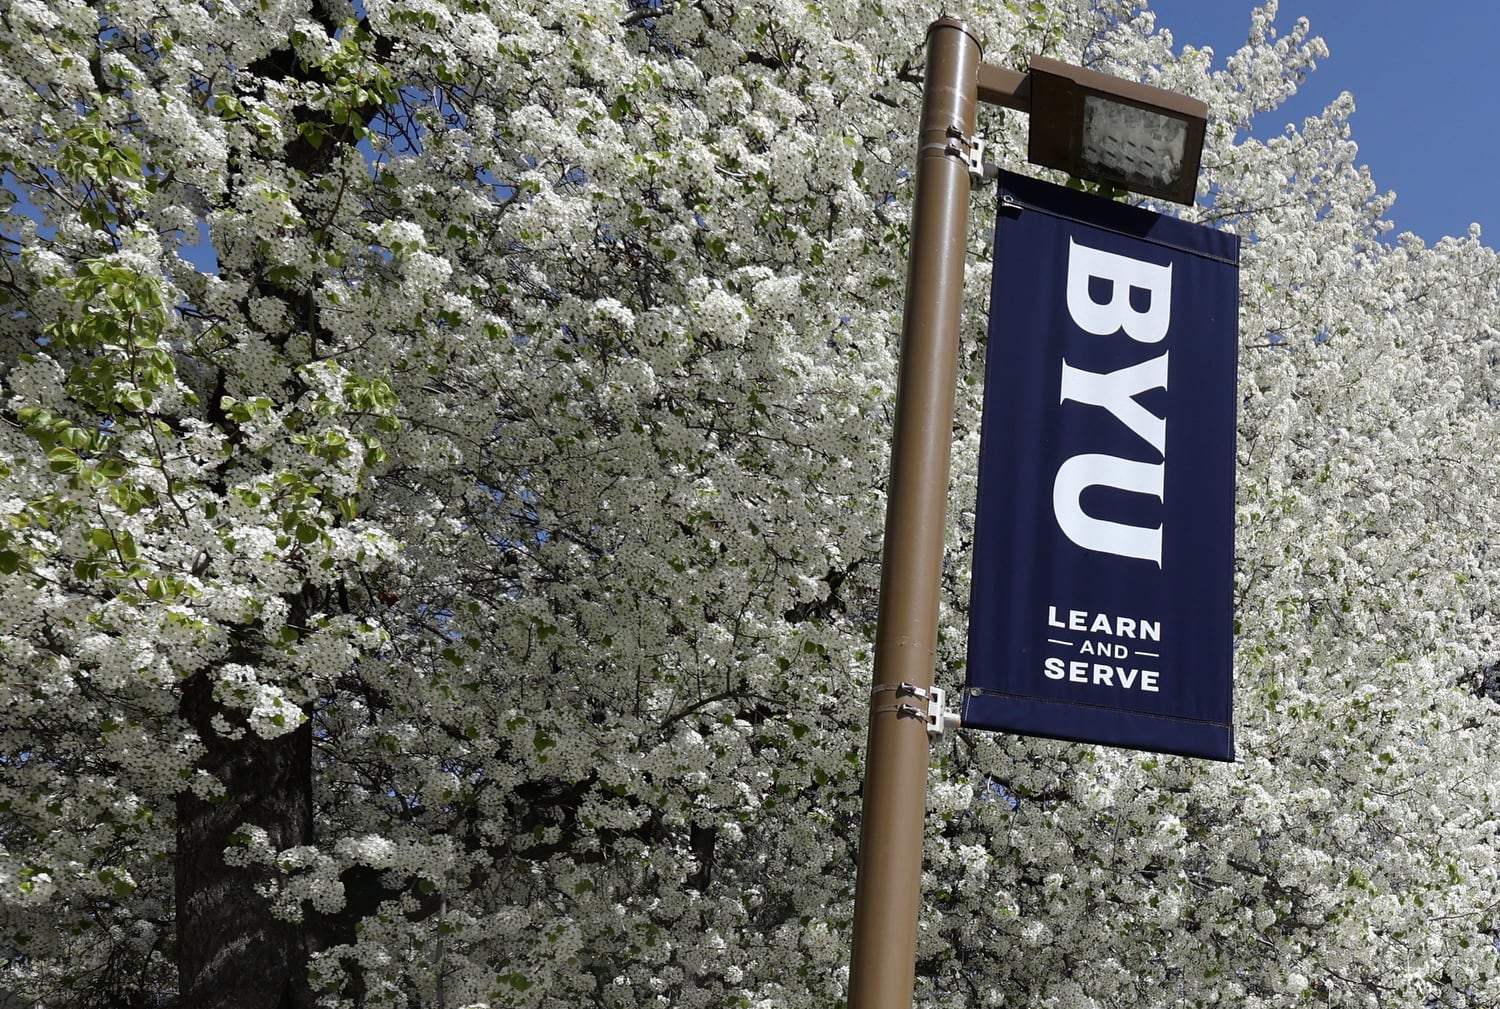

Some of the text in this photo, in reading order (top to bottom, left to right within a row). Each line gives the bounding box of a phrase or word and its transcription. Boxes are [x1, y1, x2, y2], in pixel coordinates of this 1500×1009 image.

[1053, 235, 1173, 570] BYU
[1047, 605, 1161, 642] LEARN
[1079, 639, 1129, 660] AND
[1043, 657, 1160, 692] SERVE
